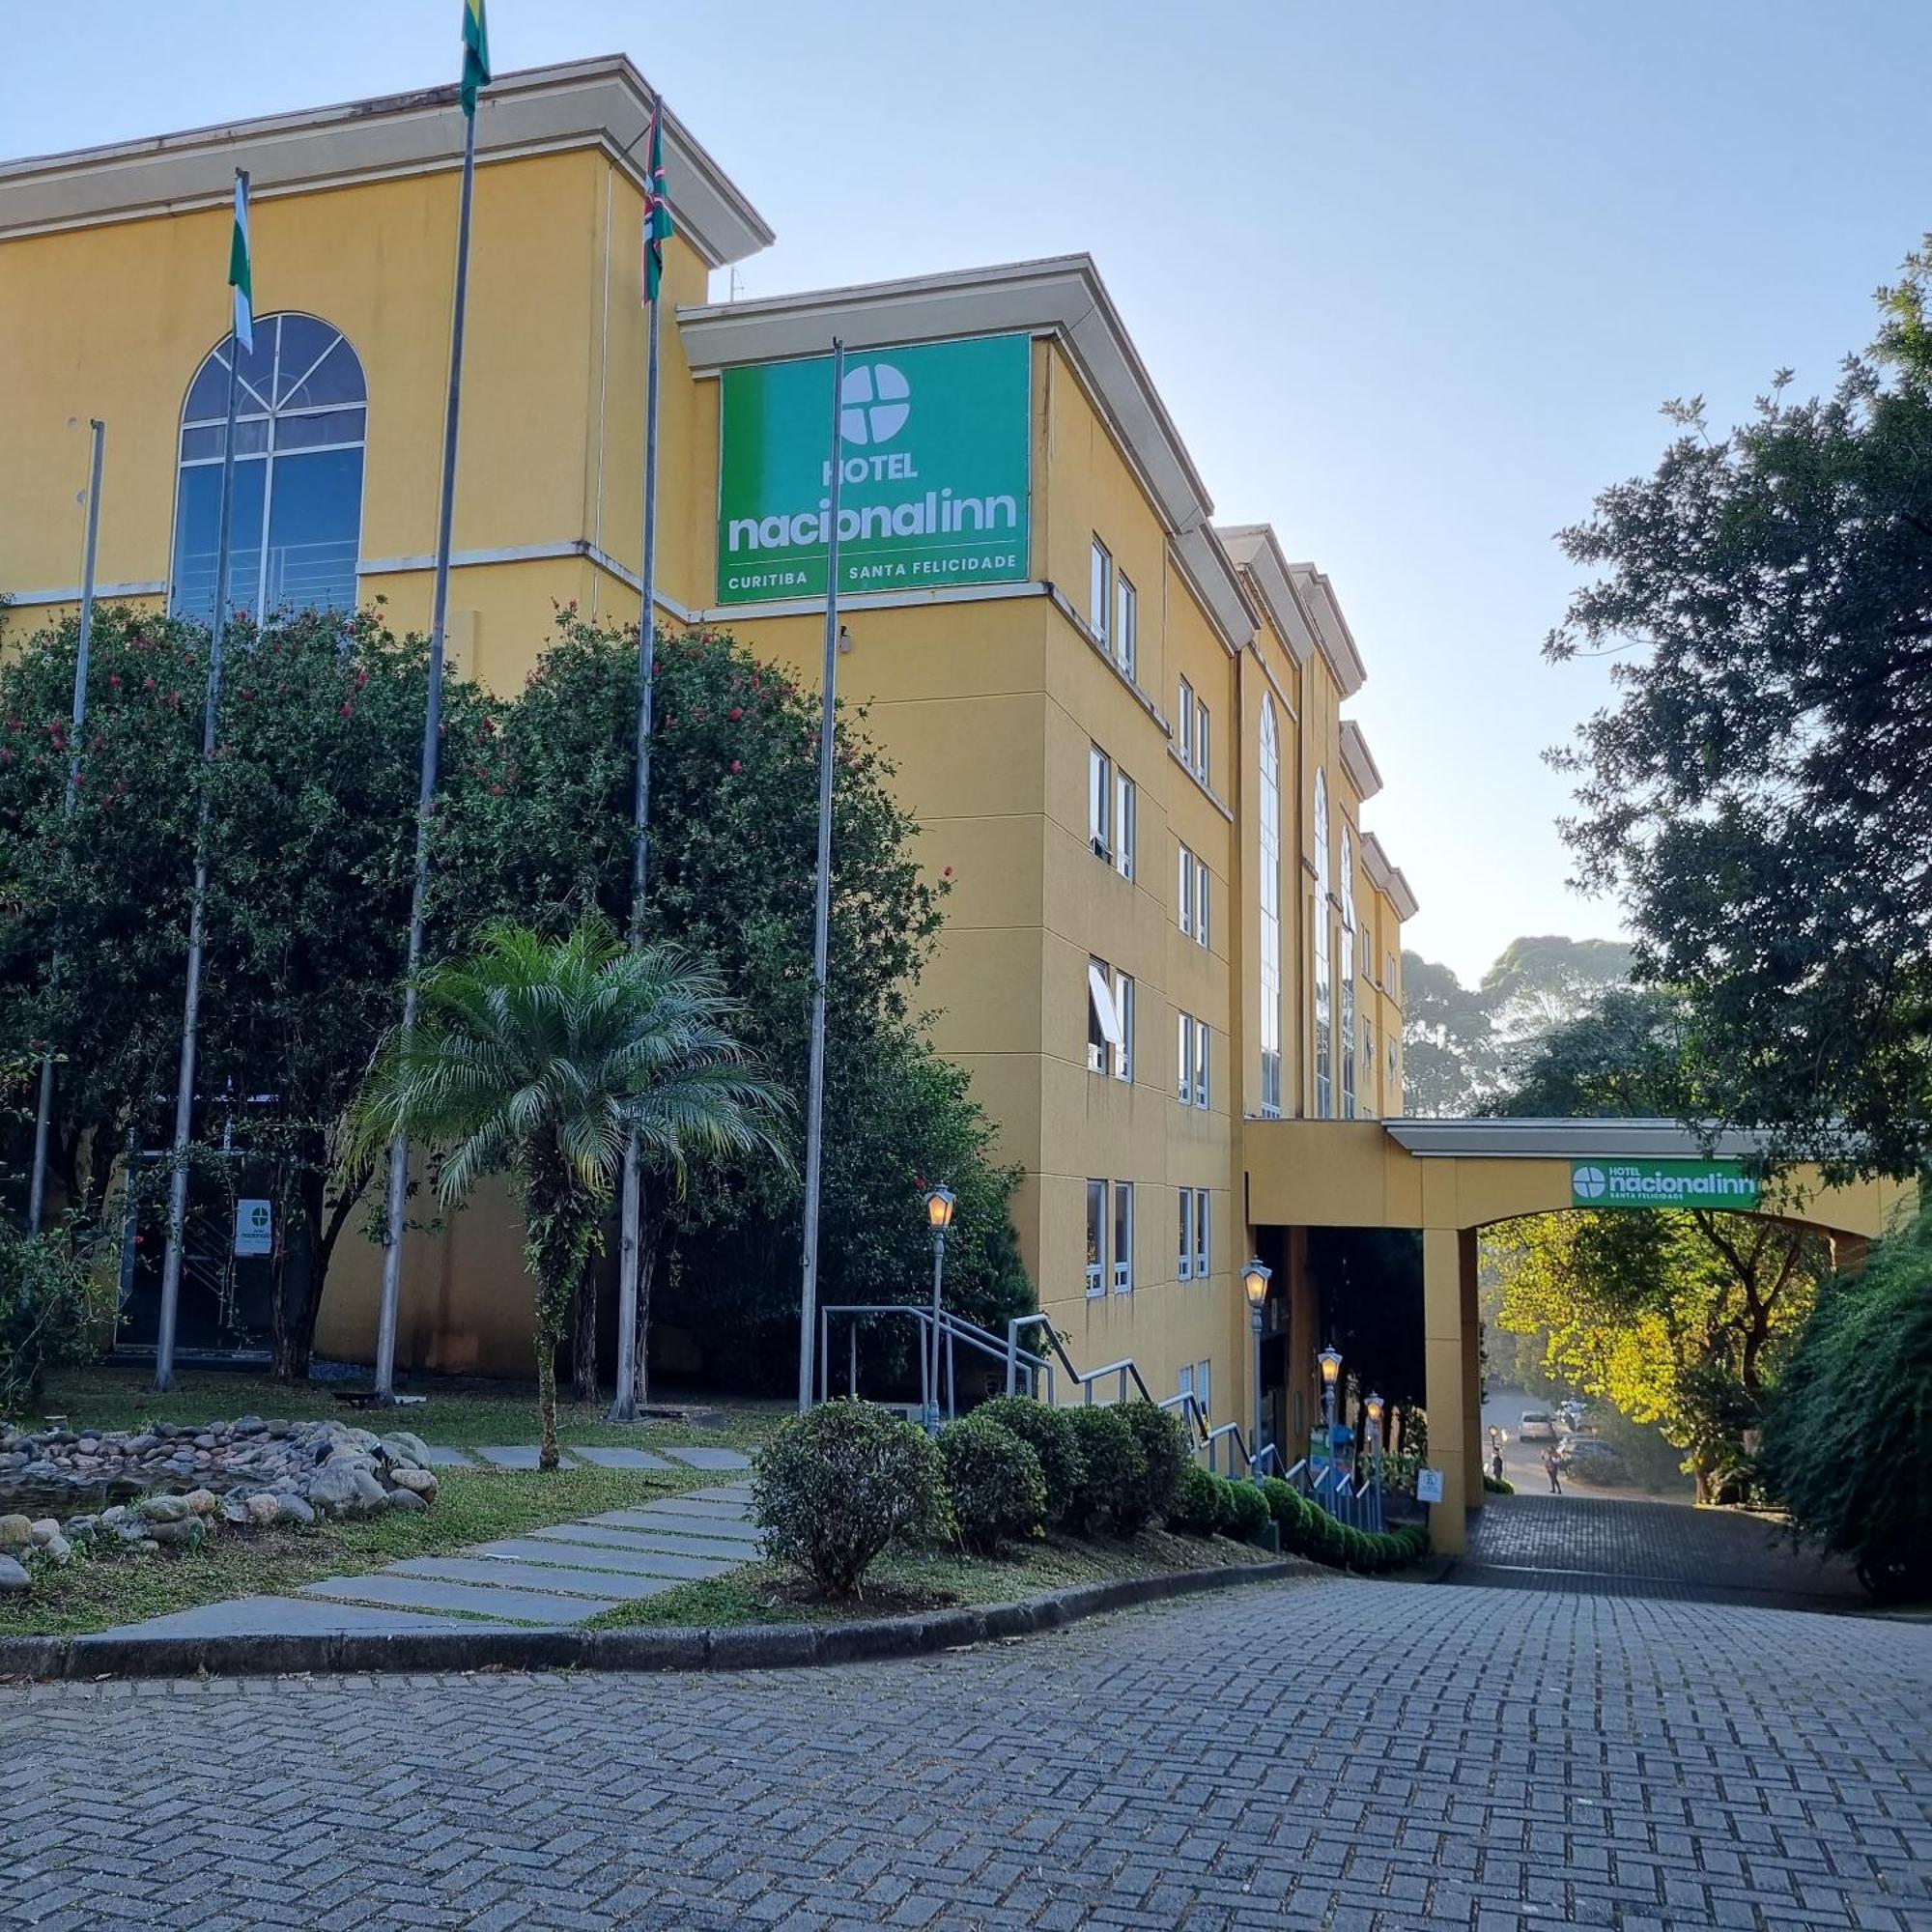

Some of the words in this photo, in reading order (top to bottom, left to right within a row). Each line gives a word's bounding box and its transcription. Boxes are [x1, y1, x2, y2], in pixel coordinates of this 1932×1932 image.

[823, 453, 918, 486] HOTEL
[729, 488, 1016, 552] nacionalinn
[728, 572, 808, 590] CURITIBA
[849, 563, 906, 580] SANTA
[913, 554, 1016, 574] FELICIDADE
[1608, 1166, 1641, 1177] HOTEL
[1609, 1171, 1755, 1195] nacionalinn
